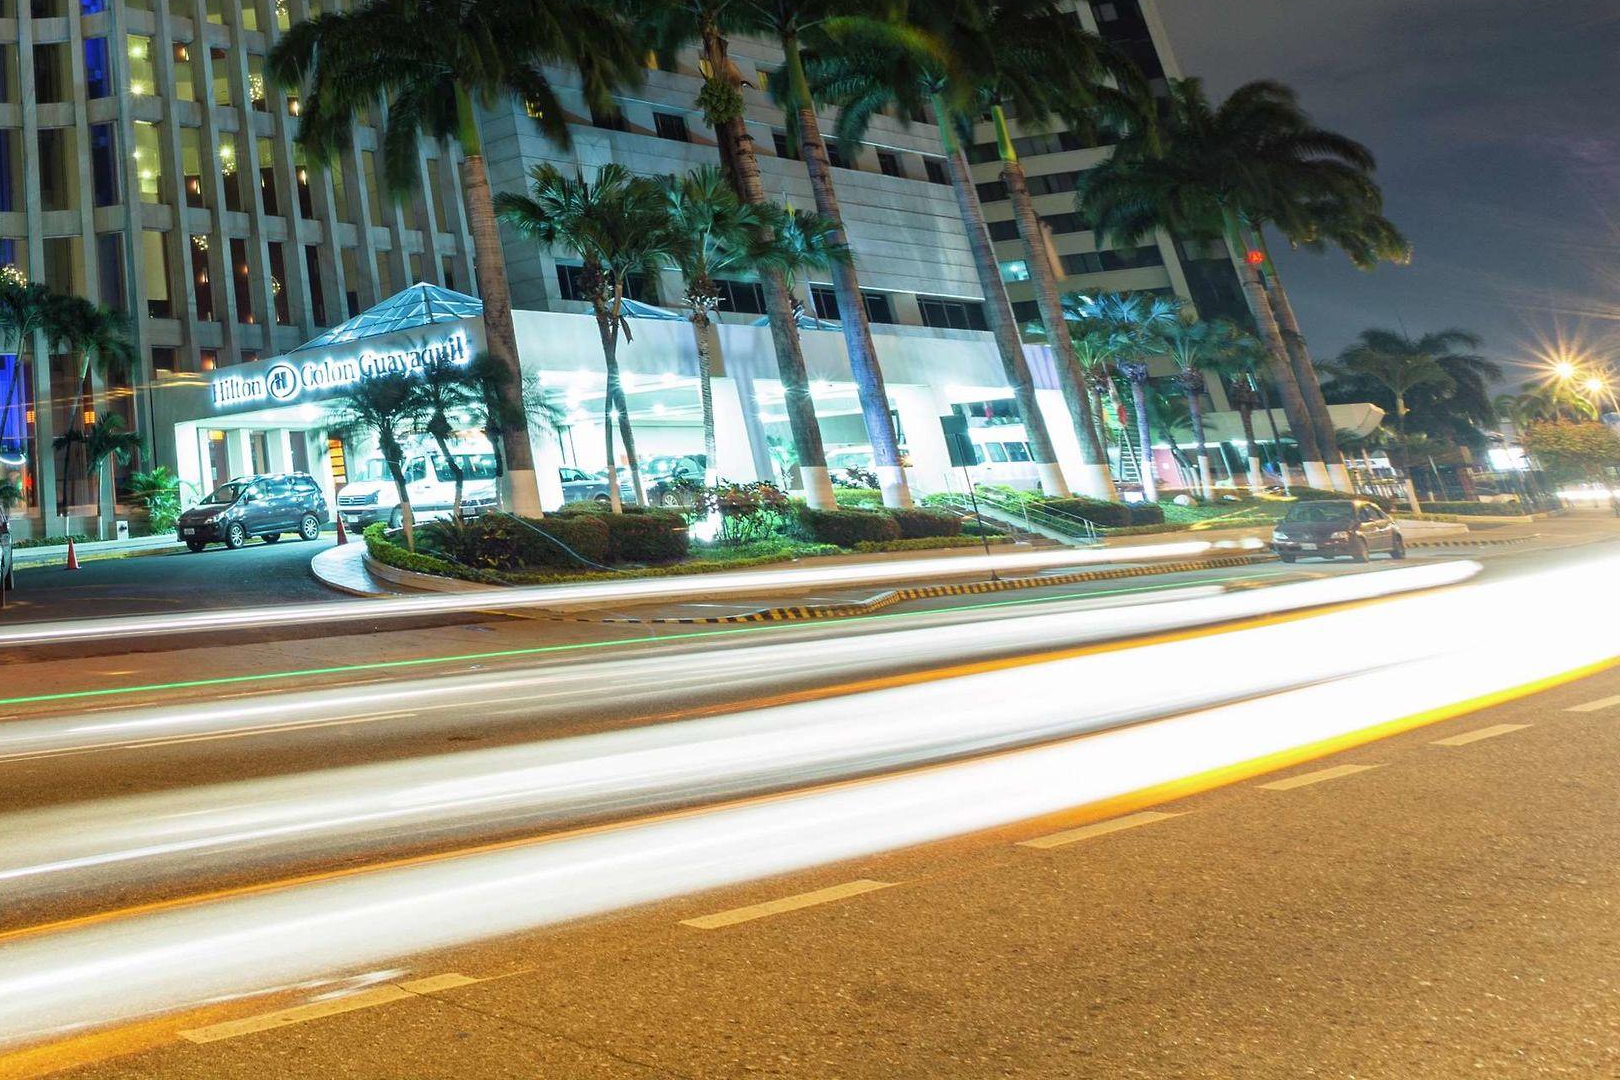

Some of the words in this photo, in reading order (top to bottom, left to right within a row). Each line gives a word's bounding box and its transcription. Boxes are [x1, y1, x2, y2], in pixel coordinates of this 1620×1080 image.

[212, 377, 261, 404] Hilton
[300, 360, 355, 388] Colon
[359, 336, 465, 379] Guayaquil
